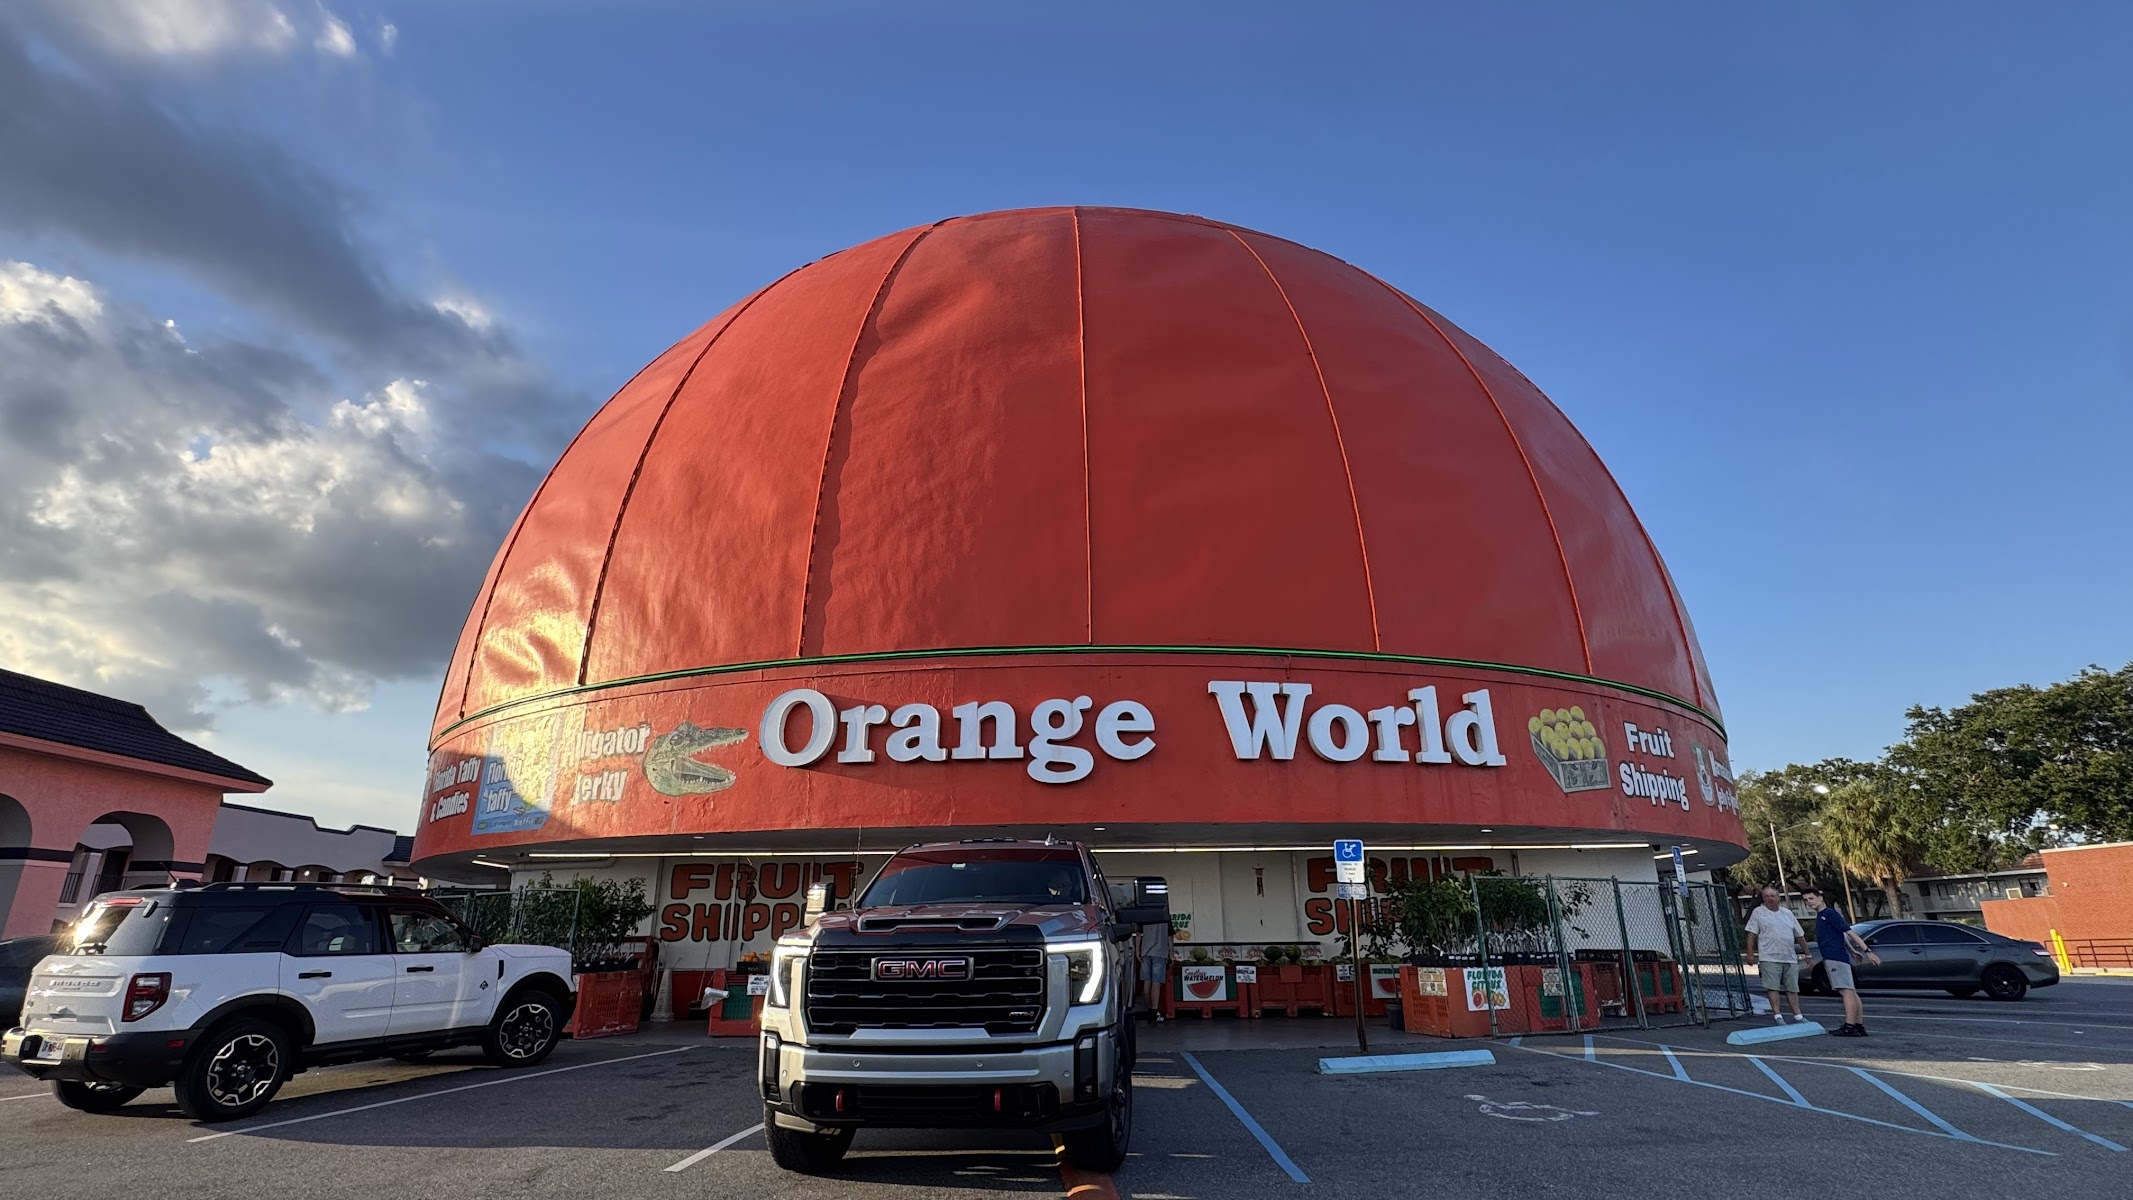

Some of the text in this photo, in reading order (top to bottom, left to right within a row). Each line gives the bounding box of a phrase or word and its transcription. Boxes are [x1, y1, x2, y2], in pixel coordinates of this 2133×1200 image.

[559, 723, 651, 768] Alligator
[760, 680, 1507, 784] Orange World
[1623, 721, 1675, 759] Fruit
[457, 757, 481, 784] Taffy
[486, 756, 523, 785] Florida
[1619, 761, 1690, 812] Shipping
[571, 769, 628, 806] Jerky
[436, 791, 470, 820] Candies
[671, 862, 864, 900] FRUIT
[660, 902, 848, 942] SHIPP
[1171, 913, 1192, 921] RIDA
[877, 959, 967, 978] GMC
[1467, 969, 1503, 981] FLOIDA
[1472, 979, 1502, 990] CITUS
